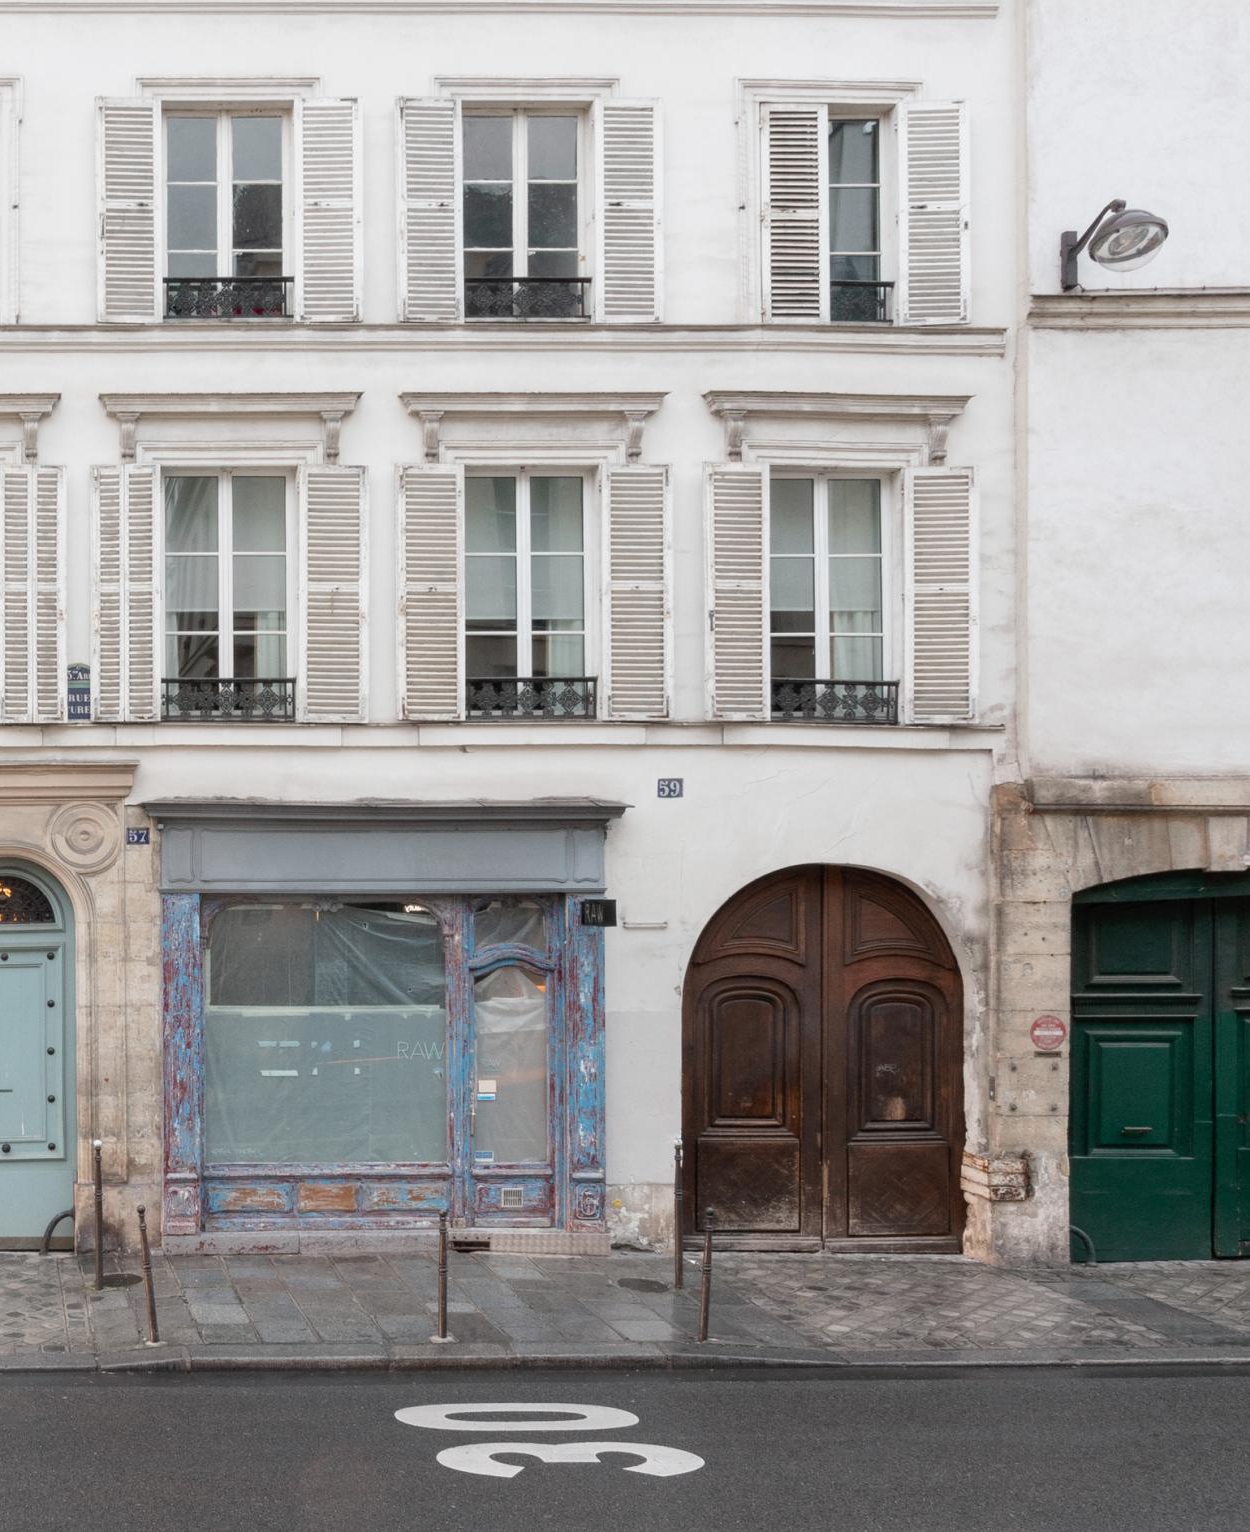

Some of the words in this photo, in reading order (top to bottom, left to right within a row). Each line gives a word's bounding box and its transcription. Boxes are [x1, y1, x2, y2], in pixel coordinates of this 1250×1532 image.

[69, 694, 90, 702] RUE
[659, 780, 680, 797] 59
[129, 830, 147, 842] 57
[585, 903, 603, 922] RAW
[397, 1041, 445, 1060] RAW
